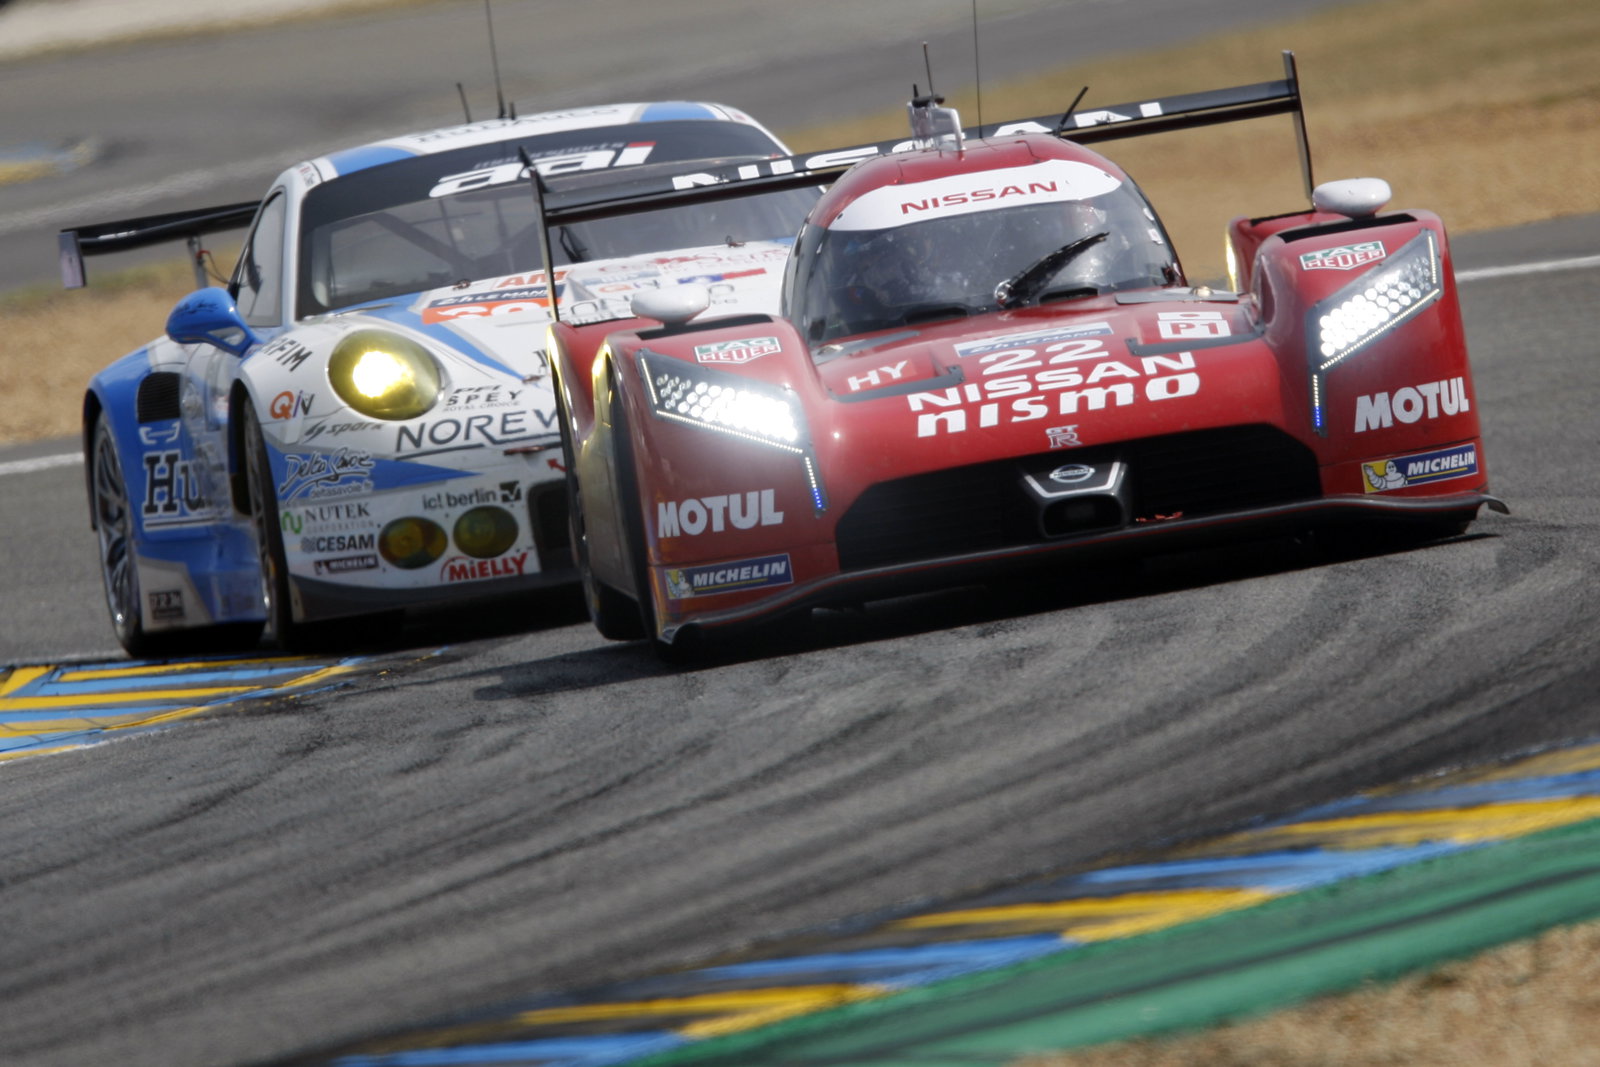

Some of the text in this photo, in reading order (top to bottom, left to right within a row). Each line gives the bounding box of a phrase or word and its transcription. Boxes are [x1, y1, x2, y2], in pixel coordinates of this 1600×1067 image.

[902, 181, 1058, 214] NISSAN
[1304, 243, 1377, 260] TAG
[1307, 251, 1382, 268] HEUER
[1170, 322, 1218, 335] P1
[701, 337, 771, 352] TAG
[702, 345, 777, 361] HEUER
[979, 338, 1109, 376] 22
[847, 360, 909, 392] HY
[907, 351, 1196, 412] NISSAN
[1354, 376, 1470, 433] MOTUL
[1407, 451, 1475, 477] MICHELIN
[446, 487, 497, 508] berlin
[305, 502, 370, 523] NUTEK
[657, 488, 784, 538] MOTUL
[316, 533, 375, 552] CESAM
[692, 560, 787, 587] MICHELIN
